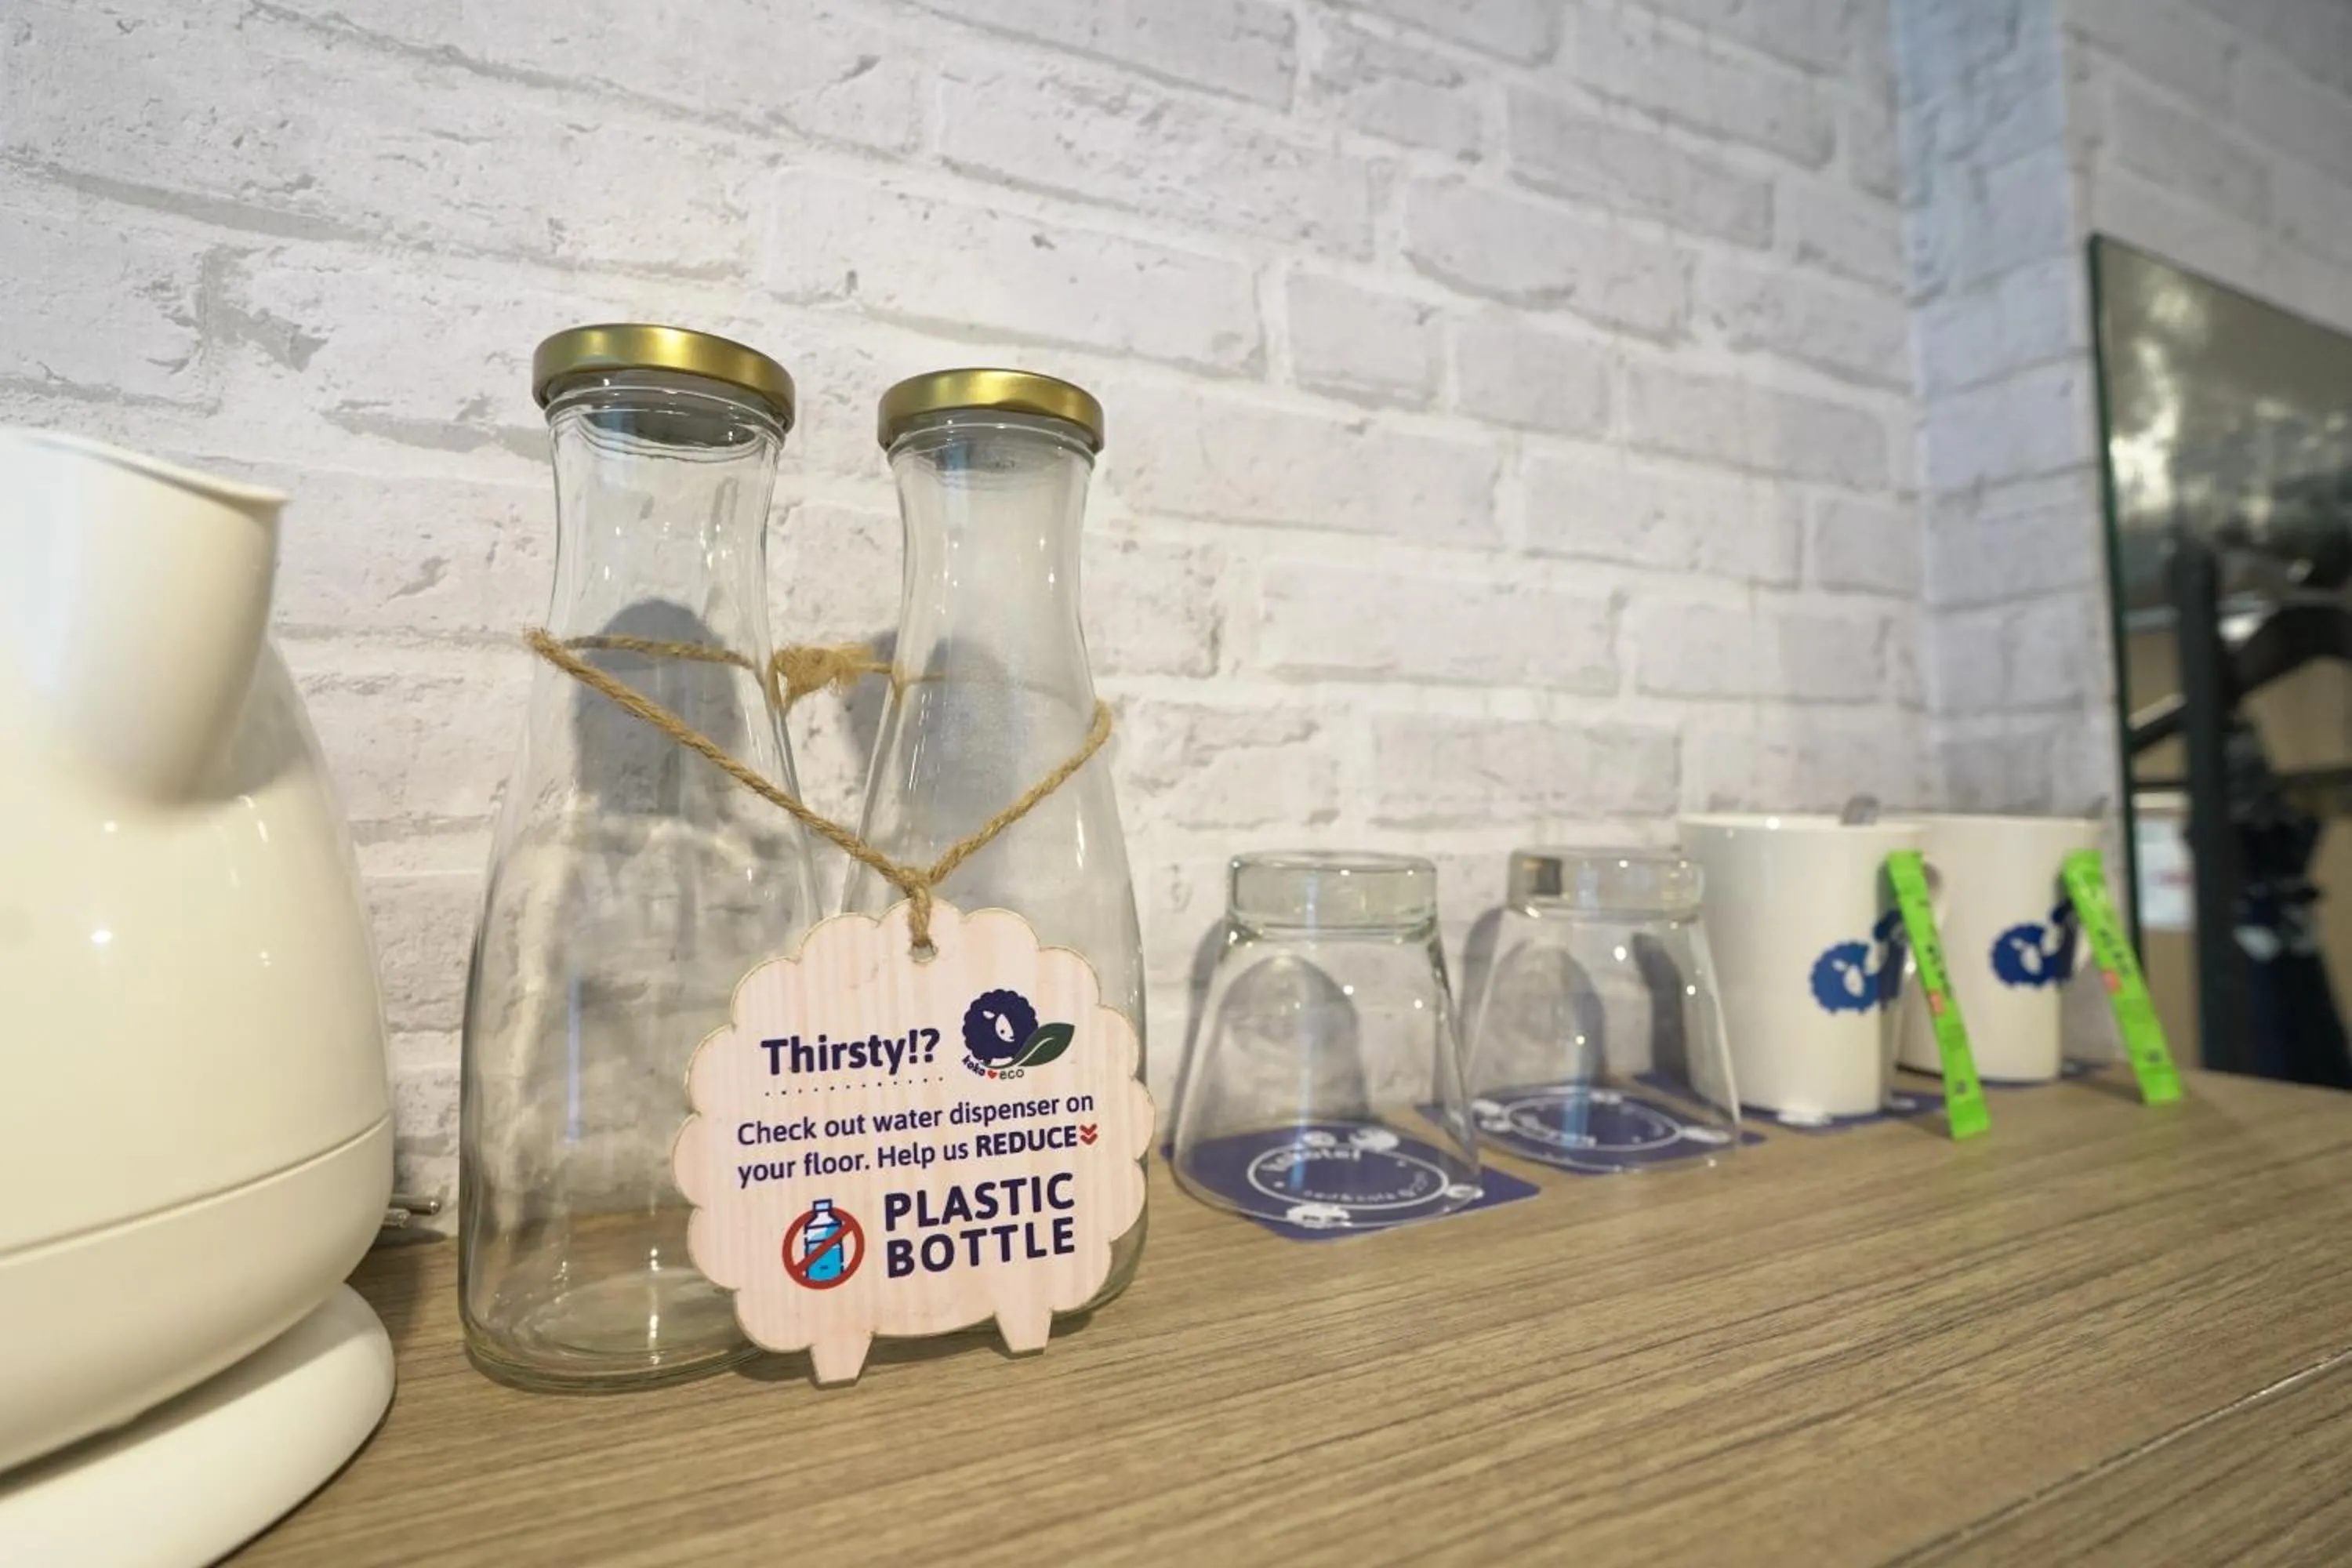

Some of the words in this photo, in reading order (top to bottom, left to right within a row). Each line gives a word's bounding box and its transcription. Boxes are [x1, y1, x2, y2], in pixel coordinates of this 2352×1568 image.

[760, 1028, 941, 1076] Thirsty!?
[1000, 1069, 1025, 1080] eco
[737, 1116, 818, 1146] Check
[824, 1115, 866, 1138] out
[872, 1109, 944, 1133] water
[949, 1098, 1061, 1127] dispenser
[1065, 1094, 1094, 1113] on
[737, 1160, 797, 1189] your
[803, 1153, 870, 1177] floor.
[877, 1142, 936, 1170] Help
[943, 1142, 969, 1161] us
[975, 1124, 1078, 1158] REDUCE
[884, 1172, 1075, 1232] PLASTIC
[887, 1216, 1076, 1279] BOTTLE
